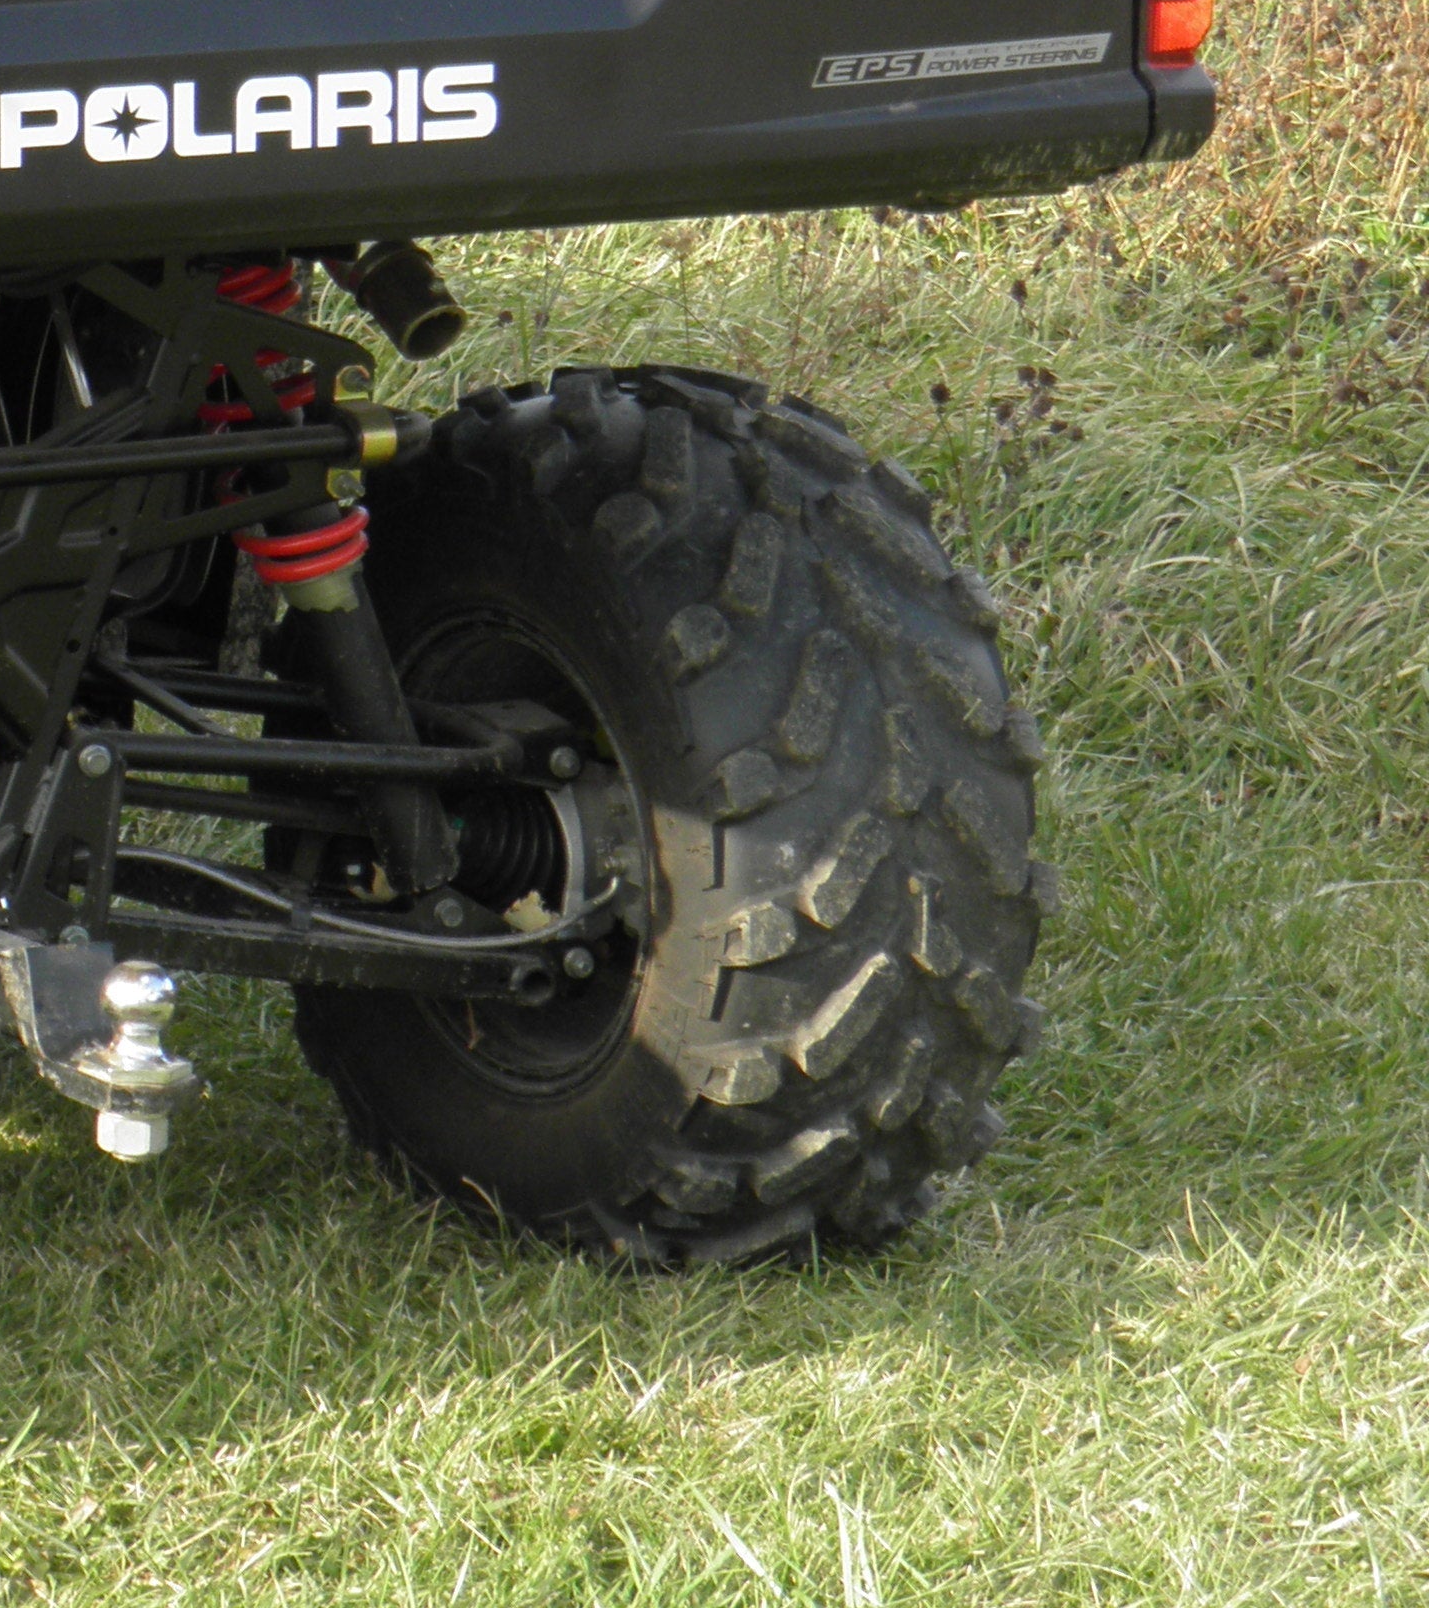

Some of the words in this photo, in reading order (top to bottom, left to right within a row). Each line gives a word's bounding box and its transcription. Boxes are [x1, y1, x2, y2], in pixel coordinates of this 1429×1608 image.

[825, 54, 913, 82] EPS
[926, 56, 999, 75] POWER
[1004, 46, 1098, 68] STEERING
[0, 61, 498, 169] POLARIS
